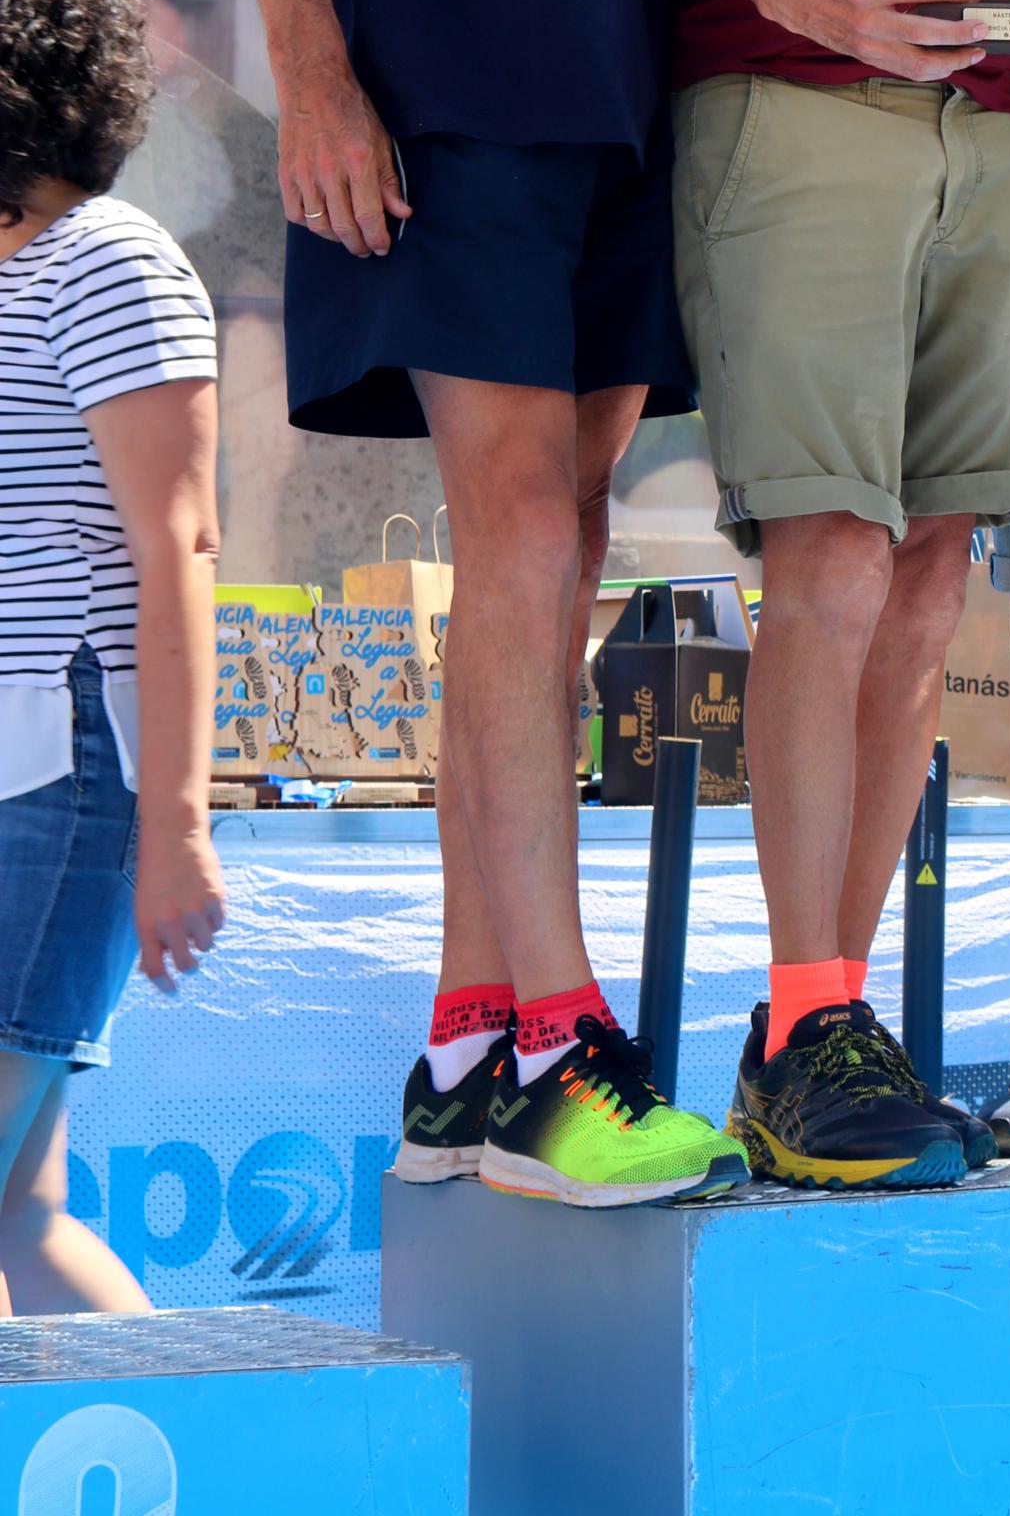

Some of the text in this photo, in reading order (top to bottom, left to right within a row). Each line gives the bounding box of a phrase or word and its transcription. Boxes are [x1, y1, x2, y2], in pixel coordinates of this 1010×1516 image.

[320, 607, 413, 628] PALENCIA
[341, 626, 415, 669] Legua
[219, 663, 240, 679] a
[380, 665, 399, 681] a
[945, 669, 1010, 698] tanás
[354, 687, 429, 731] Legua
[690, 692, 741, 725] Cerrato
[633, 685, 654, 767] Cerrato
[435, 1009, 506, 1030] VILLA DE
[443, 1001, 490, 1018] CROSS
[539, 1023, 561, 1037] DE
